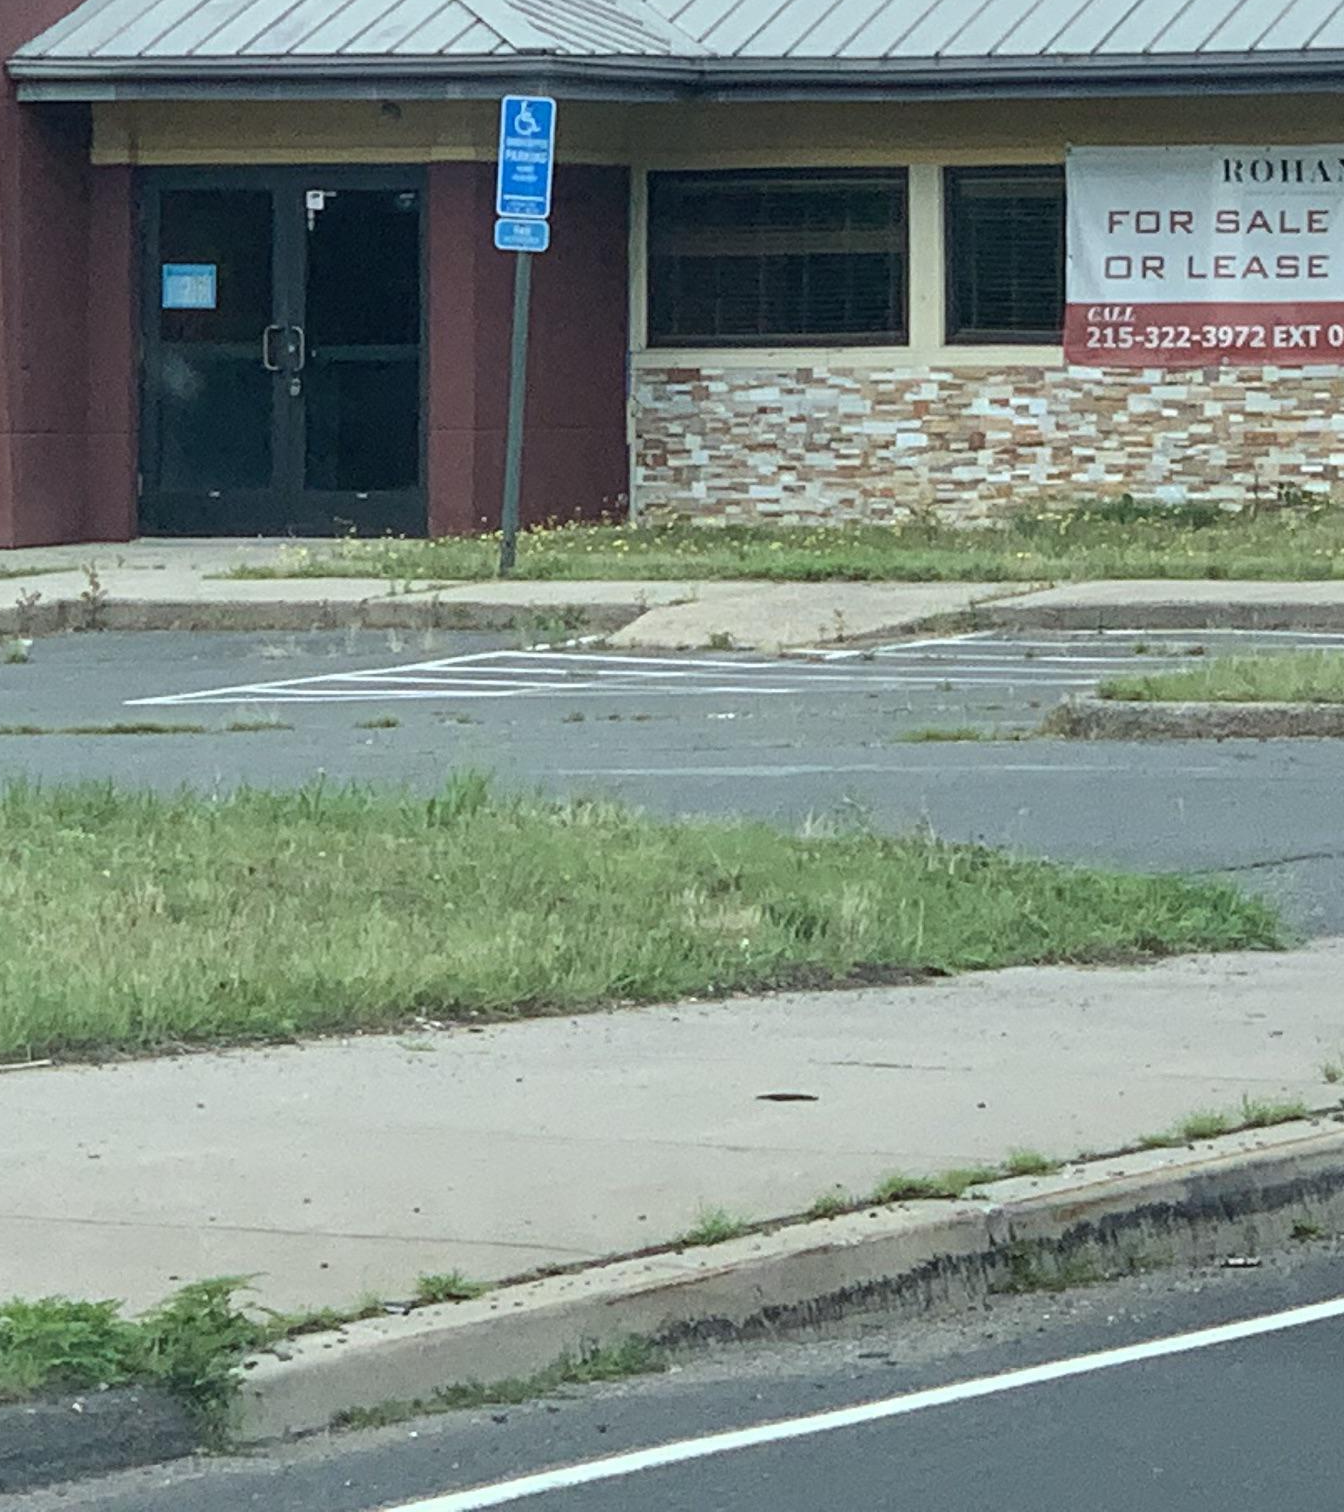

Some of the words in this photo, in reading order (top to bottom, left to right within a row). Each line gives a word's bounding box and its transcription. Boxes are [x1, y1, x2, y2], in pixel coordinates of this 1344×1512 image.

[1107, 210, 1194, 235] FOR
[1215, 209, 1331, 235] SALE
[1104, 255, 1166, 280] OR
[1187, 254, 1331, 279] LEASE
[1086, 306, 1137, 323] CALL
[1085, 324, 1267, 349] 215-322-3972
[1272, 324, 1322, 348] EXT
